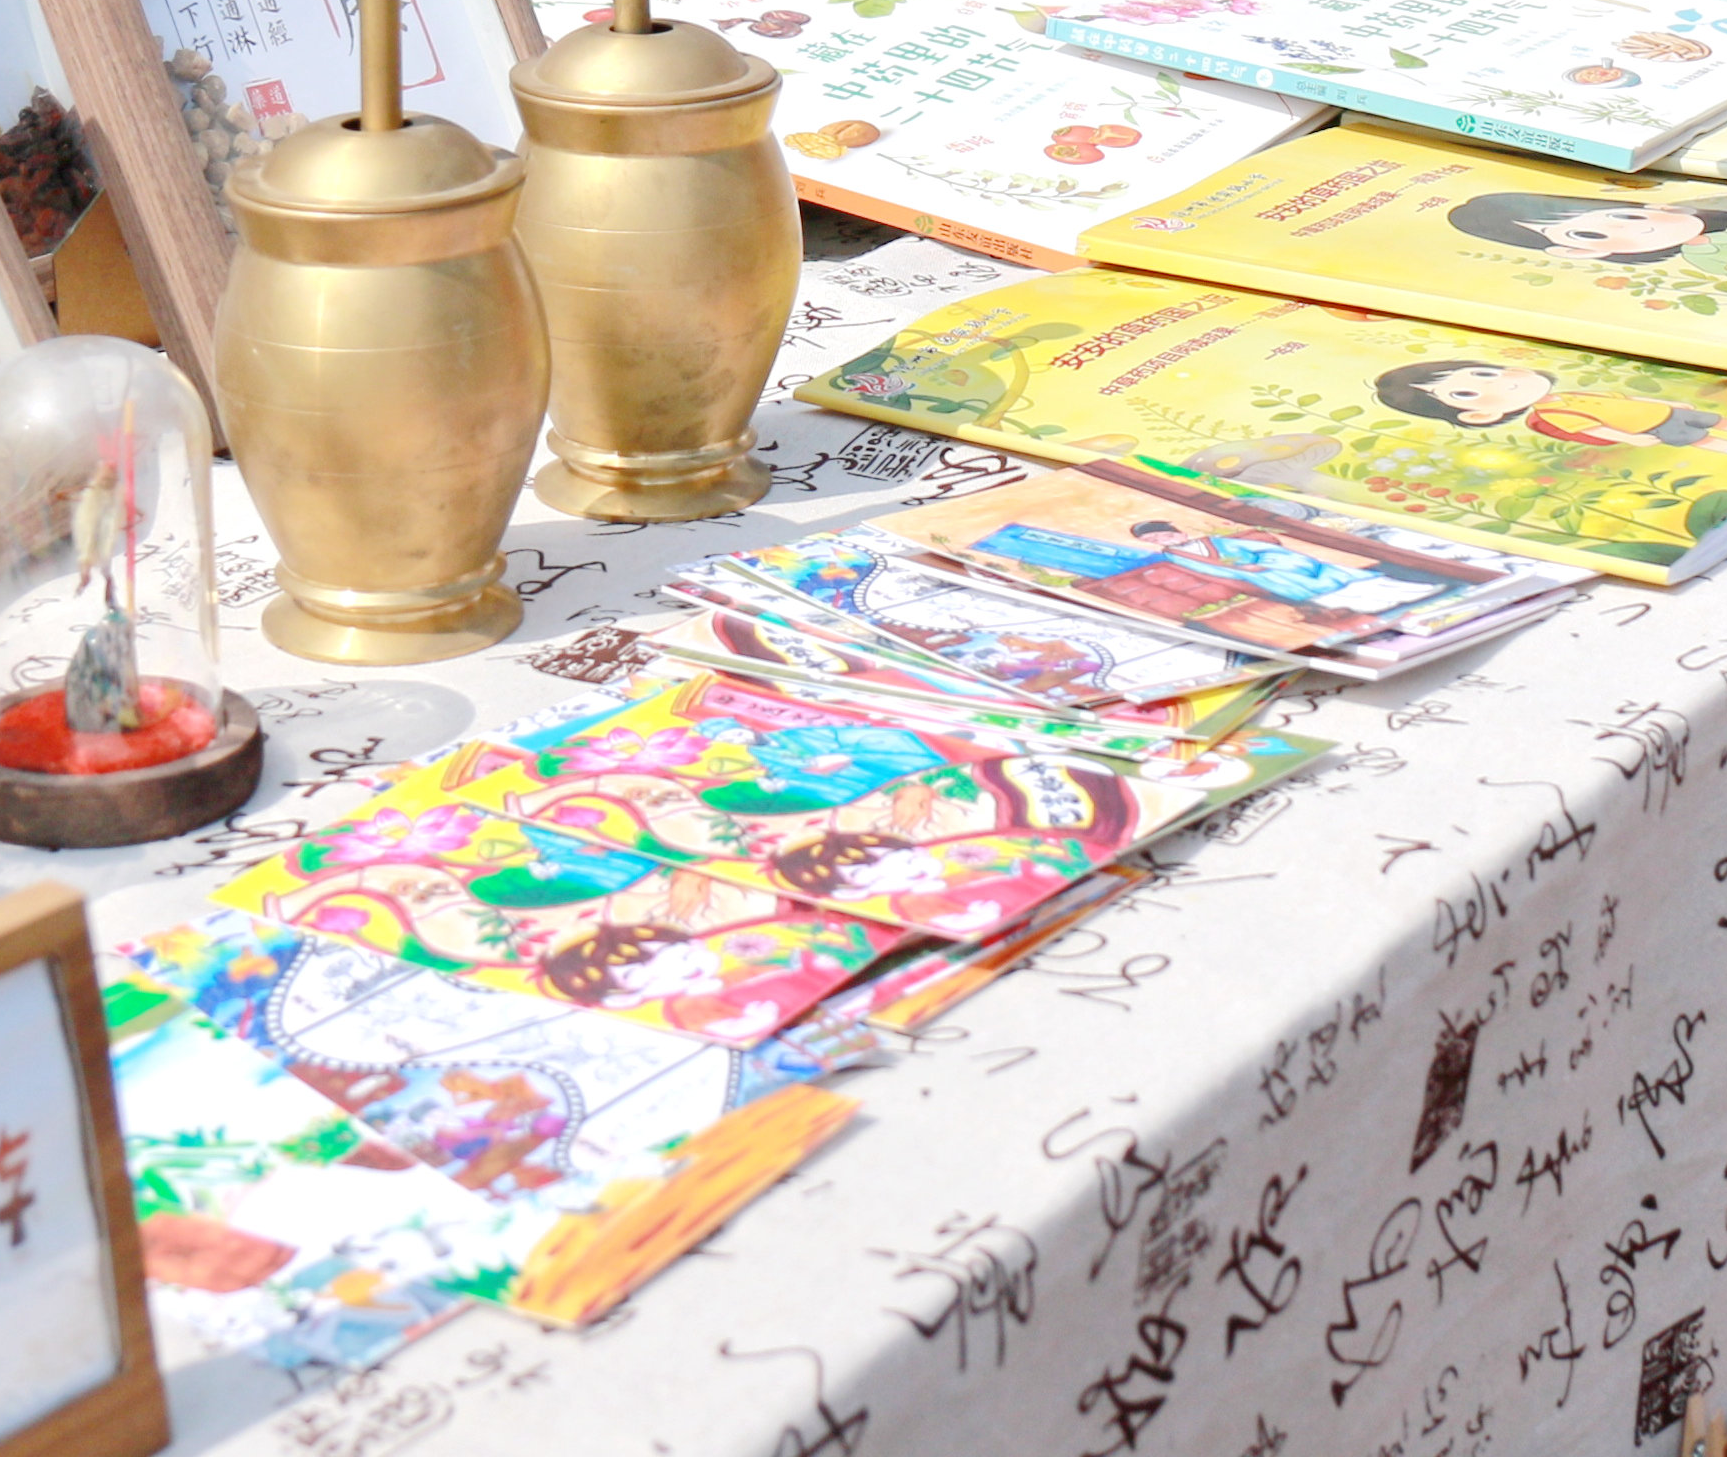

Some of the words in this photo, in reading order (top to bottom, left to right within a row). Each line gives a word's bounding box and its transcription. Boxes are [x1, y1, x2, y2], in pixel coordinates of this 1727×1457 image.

[796, 28, 877, 63] 藏在
[823, 24, 987, 99] 中药里的
[880, 38, 1054, 125] 二十四节气
[1480, 120, 1577, 153] 山东友谊出版社
[1255, 158, 1407, 221] 安安的草药国之旅
[937, 222, 1034, 261] 山东友谊出版社
[1046, 293, 1239, 372] 安安的草药国之旅
